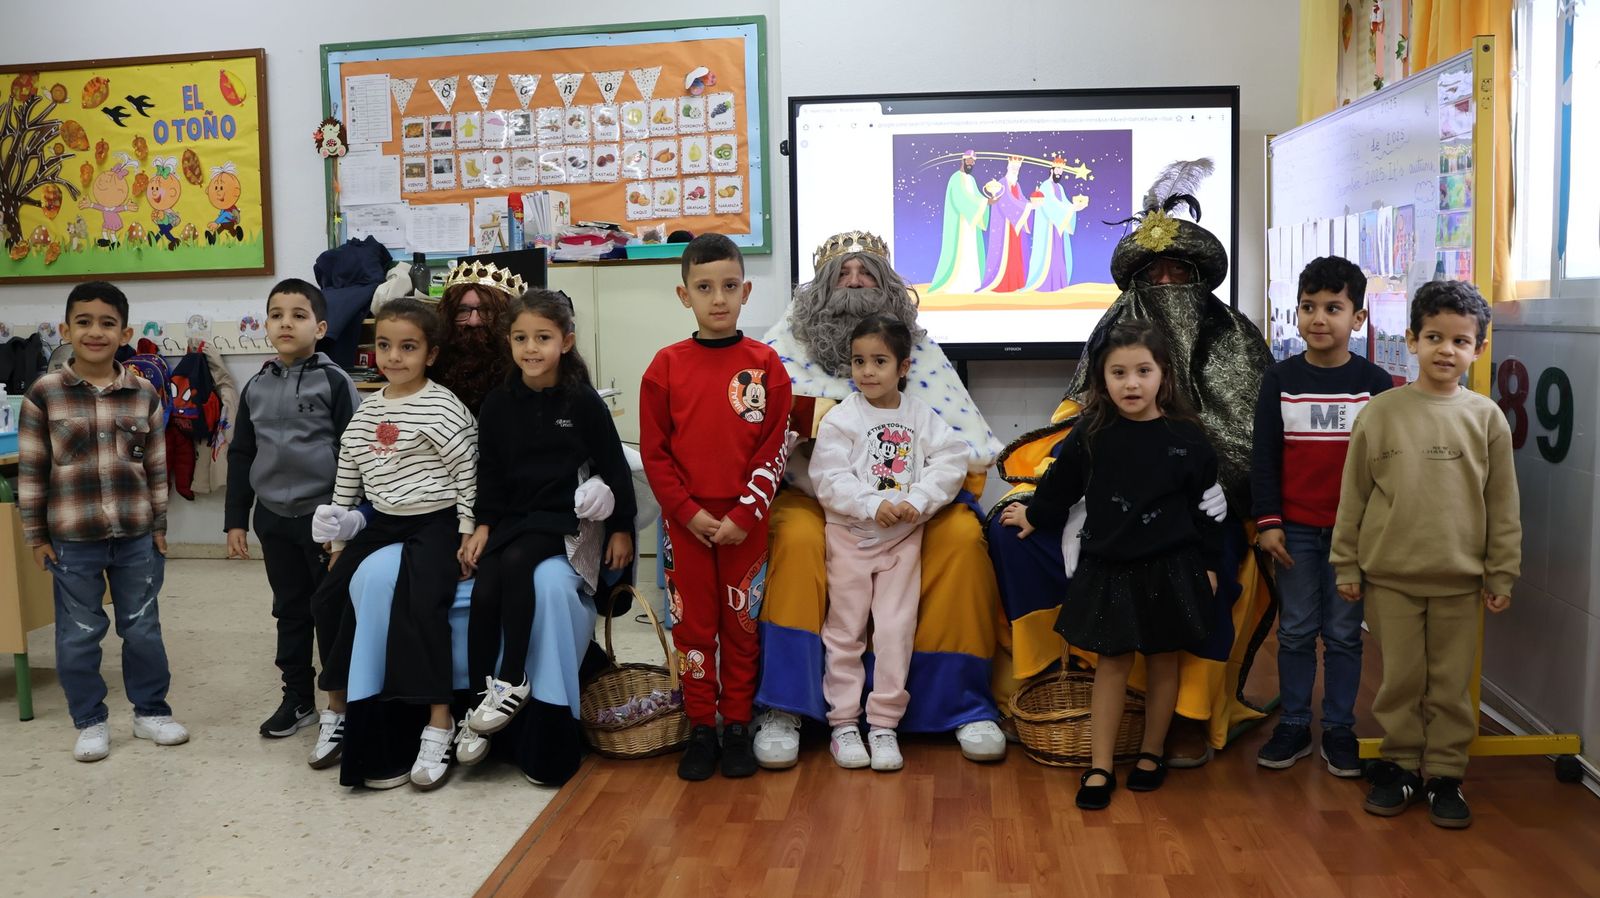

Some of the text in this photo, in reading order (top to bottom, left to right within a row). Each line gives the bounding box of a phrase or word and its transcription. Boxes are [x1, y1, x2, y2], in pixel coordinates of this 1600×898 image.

[182, 84, 204, 113] EL
[153, 109, 236, 145] OTOÑO
[1310, 404, 1339, 430] M
[1497, 358, 1574, 464] 8 9
[886, 422, 915, 434] TOGETHE
